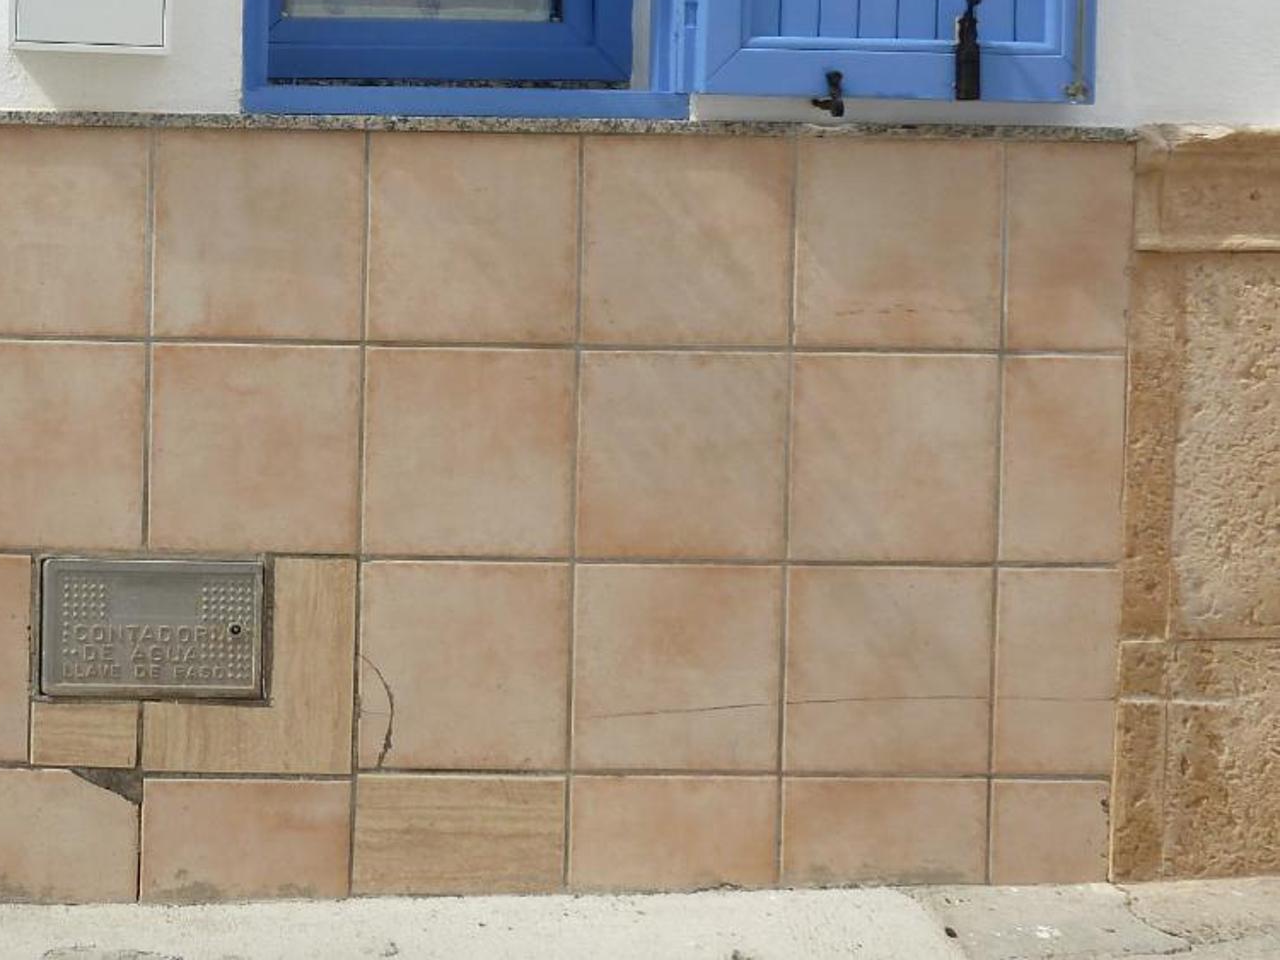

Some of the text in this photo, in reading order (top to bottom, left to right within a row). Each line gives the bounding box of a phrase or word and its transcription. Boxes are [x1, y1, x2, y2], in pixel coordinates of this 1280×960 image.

[73, 623, 208, 642] CONTADOR
[82, 643, 197, 662] DE AGUA
[62, 663, 228, 680] LLAVE DE PASO
